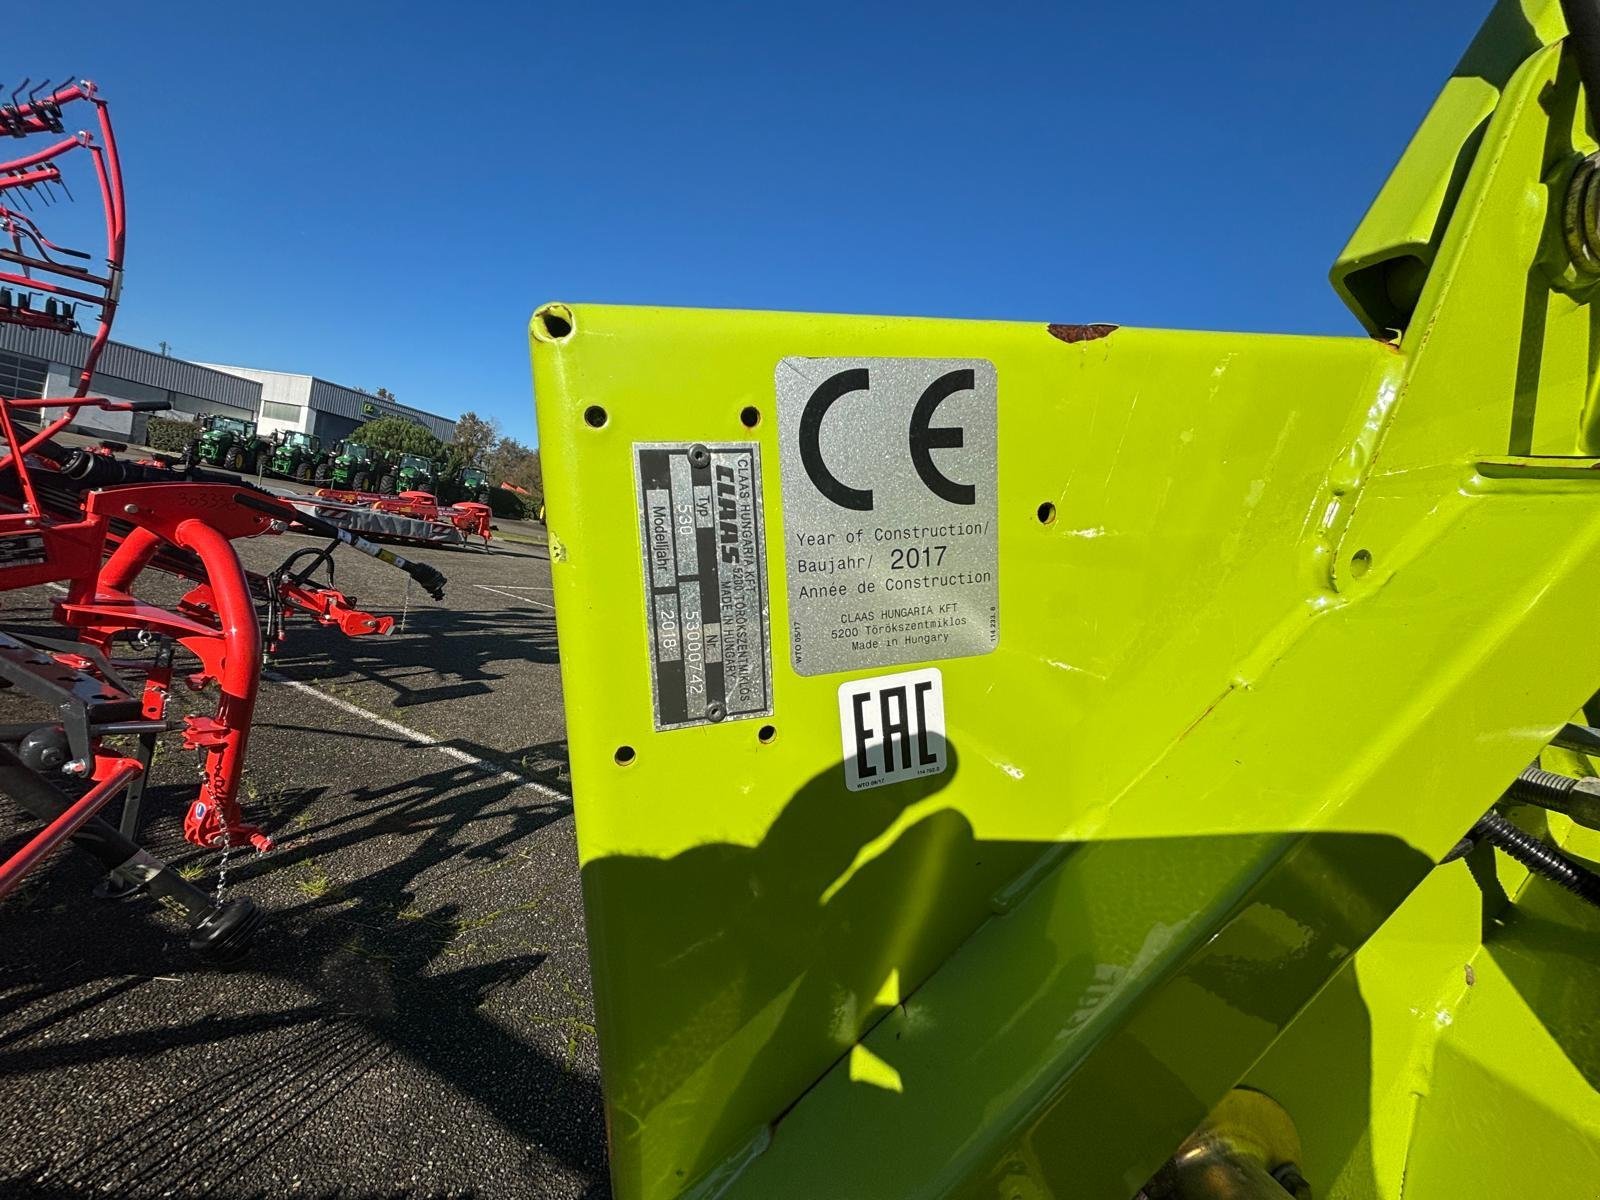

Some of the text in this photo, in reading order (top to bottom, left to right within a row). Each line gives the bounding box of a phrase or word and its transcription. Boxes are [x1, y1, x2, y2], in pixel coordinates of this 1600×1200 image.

[799, 368, 976, 511] CE
[678, 504, 693, 535] 530
[698, 495, 710, 517] Typ
[716, 464, 740, 564] CLAAS
[652, 506, 670, 571] Modelljahr
[737, 459, 756, 593] CLAAS HUNGARIA KFT
[796, 521, 989, 547] Year of Construction/
[798, 546, 947, 574] Baujahr/ 2017
[732, 568, 743, 593] 5200
[799, 570, 991, 599] Année de Construction
[840, 602, 958, 624] CLAAS HUNGARIA KFT
[661, 610, 677, 649] 2018
[706, 635, 718, 648] Nr.
[721, 581, 737, 678] MADE IN HUNGARY
[831, 627, 859, 639] 5200
[851, 632, 949, 651] Made in Hungary
[685, 611, 703, 694] 53000742
[794, 645, 802, 664] WTO
[852, 681, 937, 778] EAC
